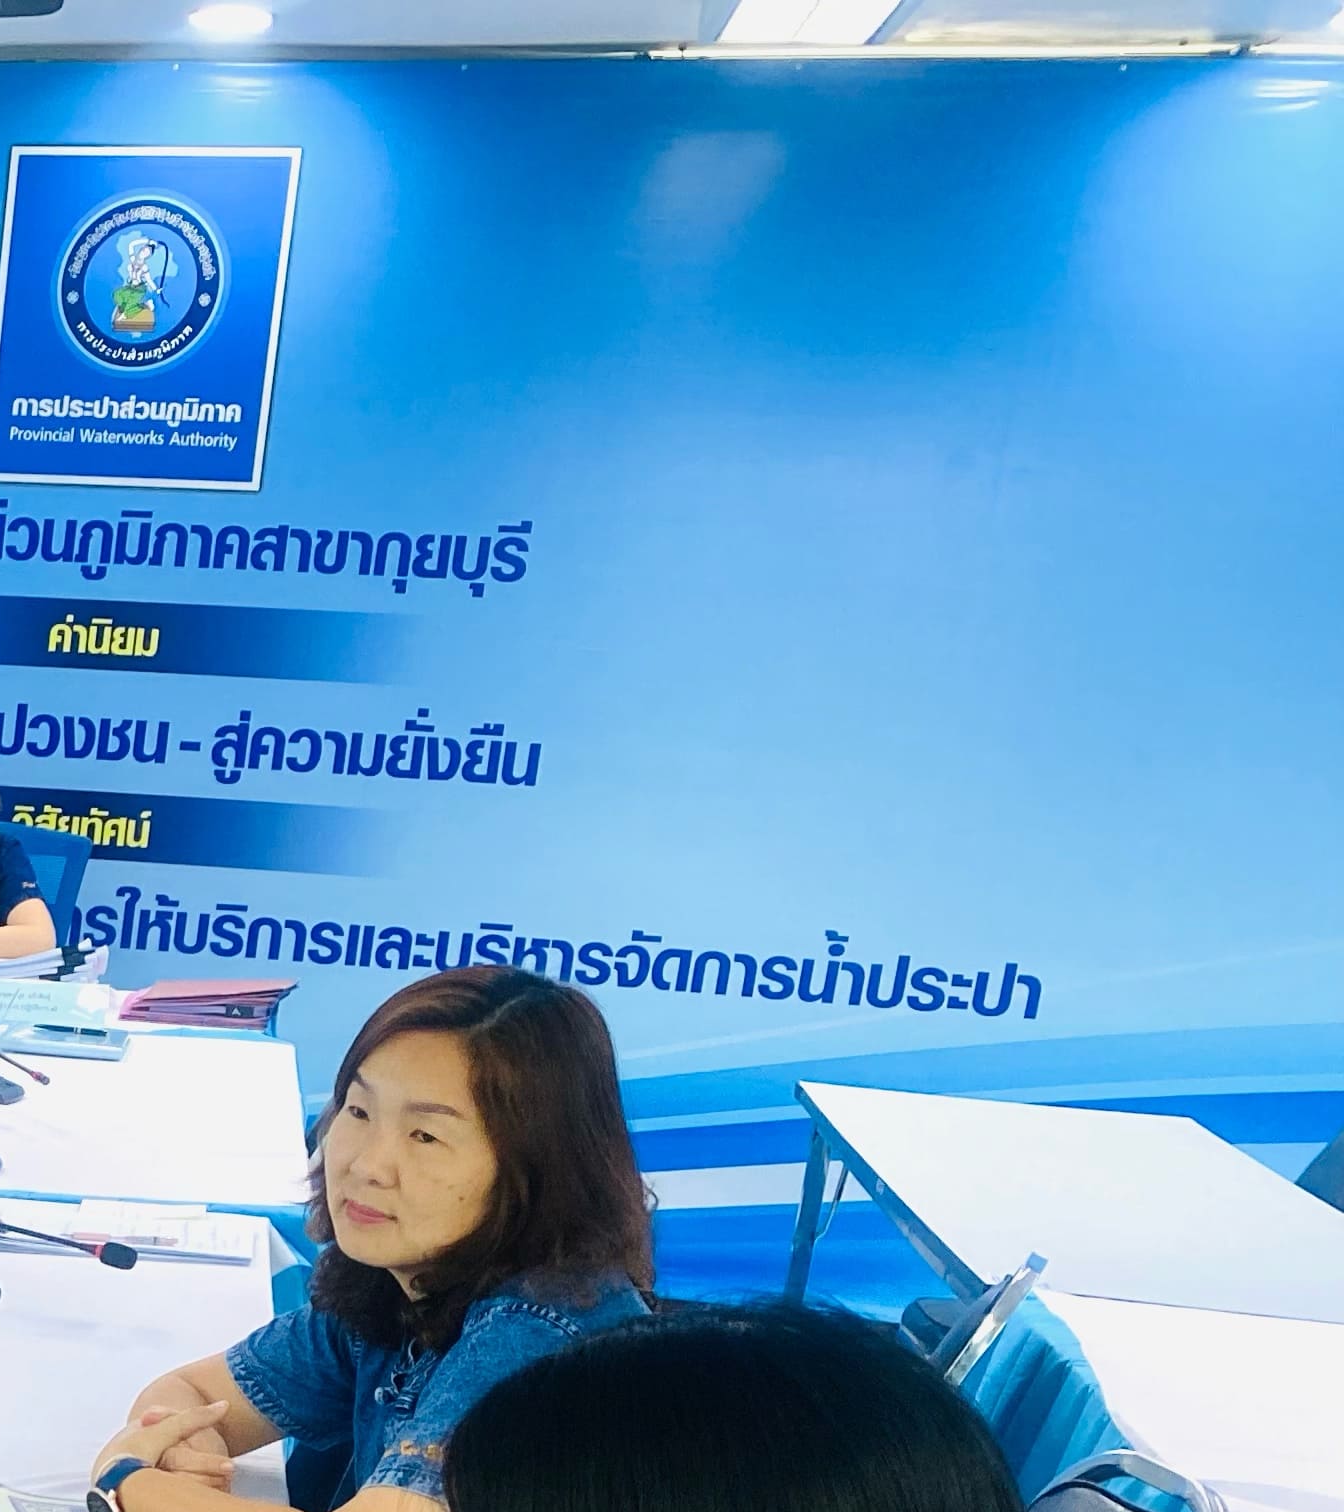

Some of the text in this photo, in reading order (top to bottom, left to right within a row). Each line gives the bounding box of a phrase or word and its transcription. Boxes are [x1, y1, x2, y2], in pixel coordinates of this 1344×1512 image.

[11, 394, 242, 427] การประปาส่วนภูมิภาค
[9, 426, 238, 451] Provincial Waterworks Authority
[47, 614, 159, 658] ค่านิยม
[210, 707, 542, 788] สู่ความยั่งยืน
